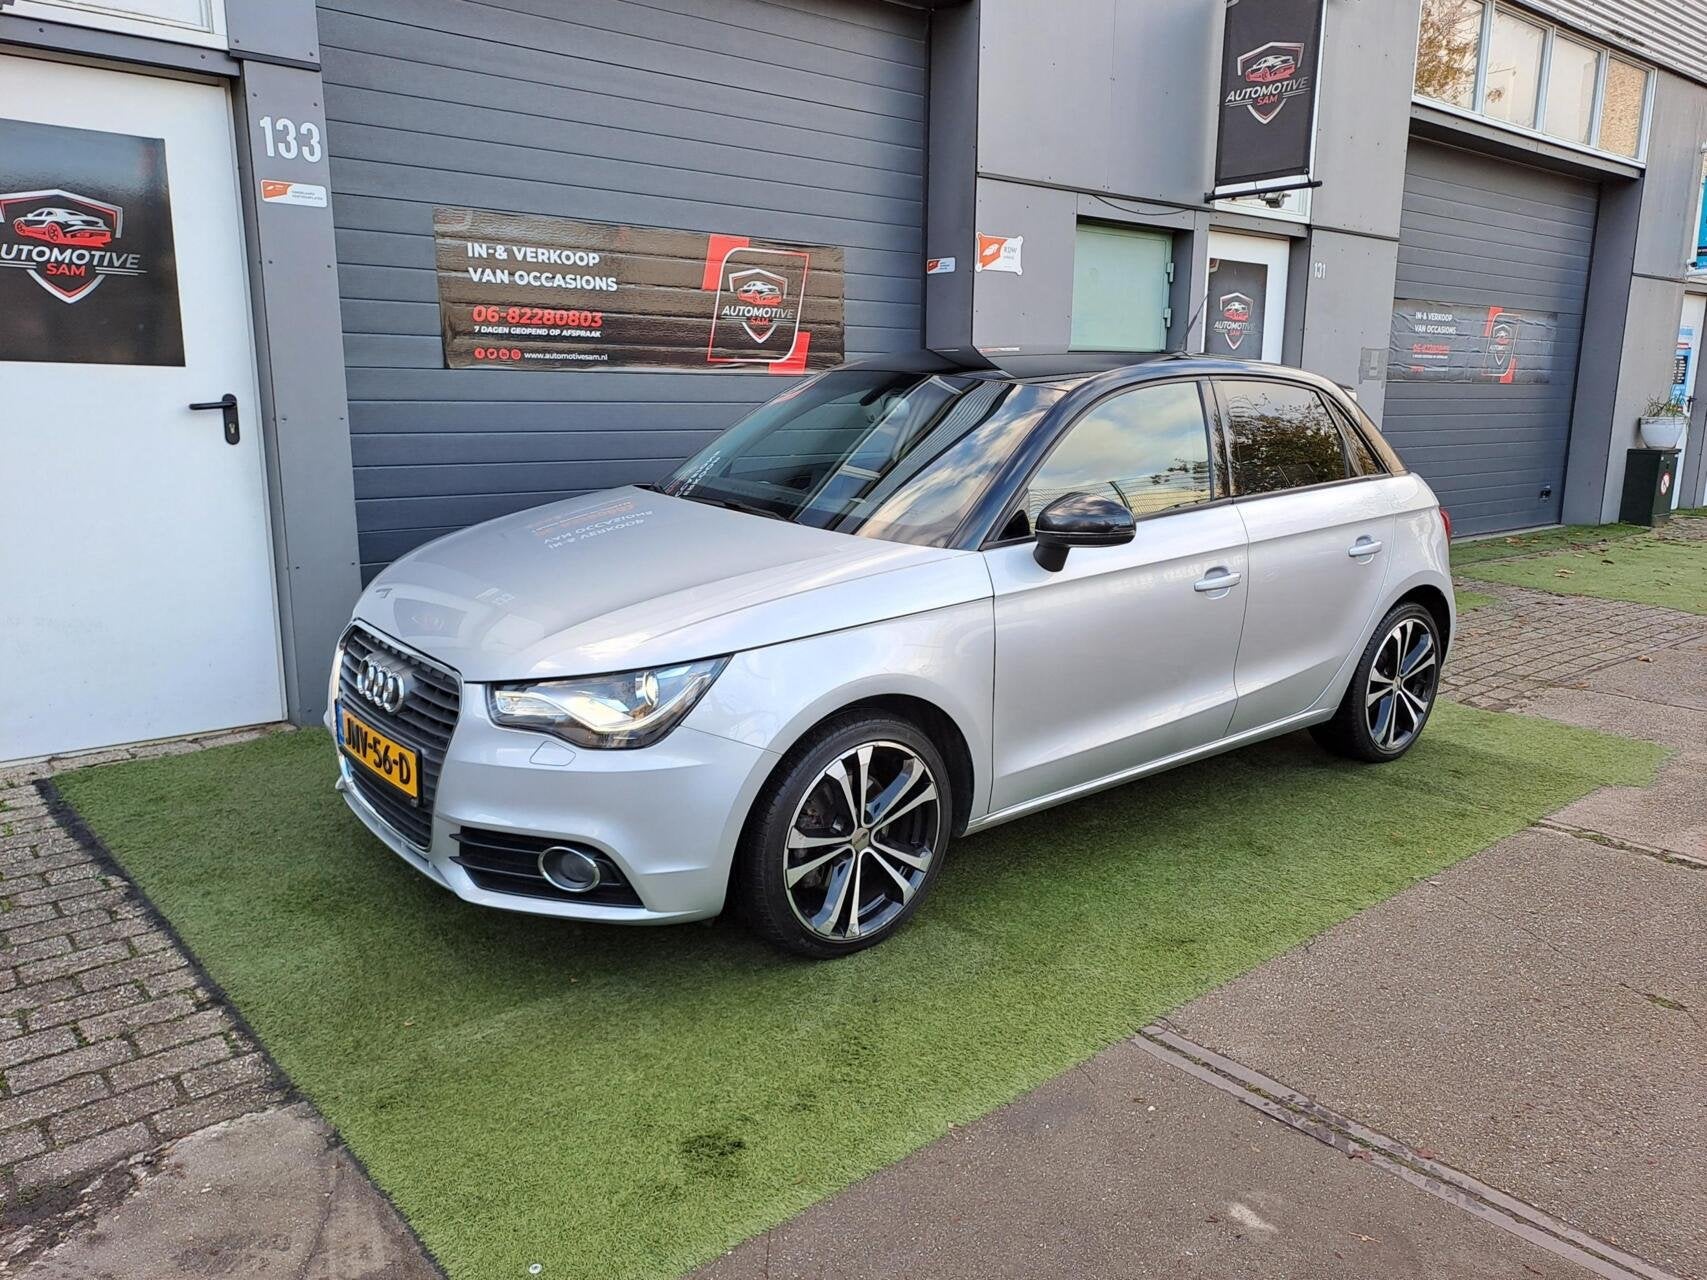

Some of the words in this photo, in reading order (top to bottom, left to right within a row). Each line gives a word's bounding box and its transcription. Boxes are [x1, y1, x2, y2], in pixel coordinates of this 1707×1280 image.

[1225, 76, 1309, 103] AUTOMOTIVE
[1256, 94, 1279, 106] SAM
[259, 116, 322, 163] 133
[0, 243, 141, 268] UTOMOTIVE
[467, 242, 508, 260] IN-&
[512, 246, 600, 267] VERKOOP
[46, 262, 86, 277] SAM
[1313, 262, 1327, 279] 131
[467, 267, 510, 284] VAN
[514, 271, 618, 291] OCCASIONS
[472, 305, 603, 327] 06-82280803
[721, 305, 795, 319] AUTOMOTIVE
[749, 318, 770, 326] SAM
[481, 326, 509, 334] DAGEN
[510, 327, 548, 336] GEOPEND
[549, 328, 561, 336] OP
[561, 329, 602, 338] AFSPRAAK
[524, 351, 608, 361] www.automotivesam.nl
